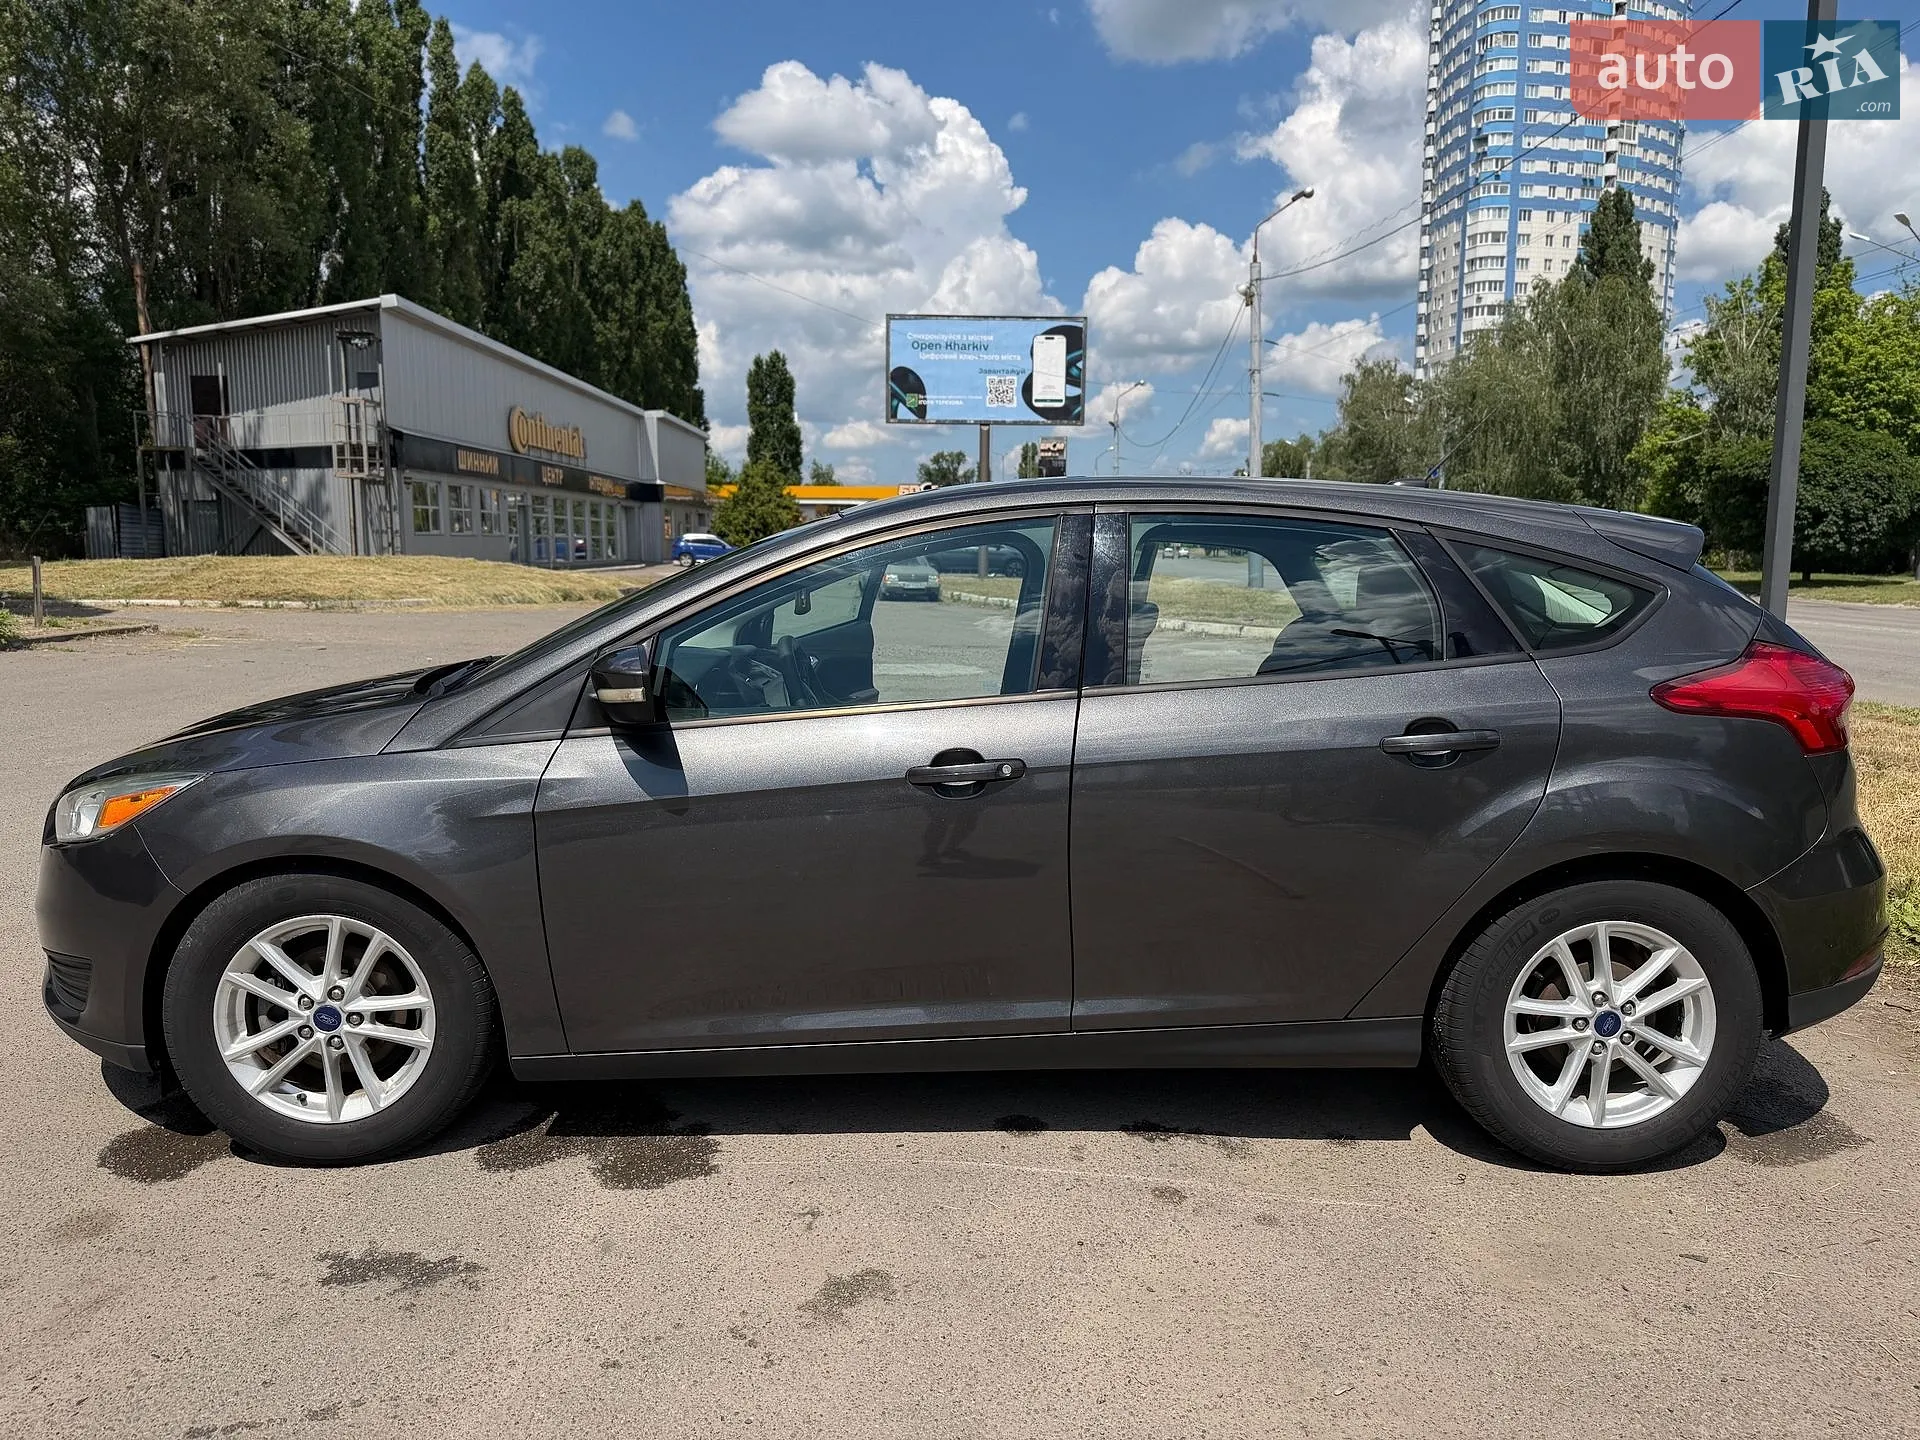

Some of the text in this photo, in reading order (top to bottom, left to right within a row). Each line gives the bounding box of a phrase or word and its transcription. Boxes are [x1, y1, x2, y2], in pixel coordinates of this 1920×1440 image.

[911, 341, 989, 352] Open Kharkiv
[509, 406, 585, 458] Continental
[541, 465, 564, 487] ЦЕНТР
